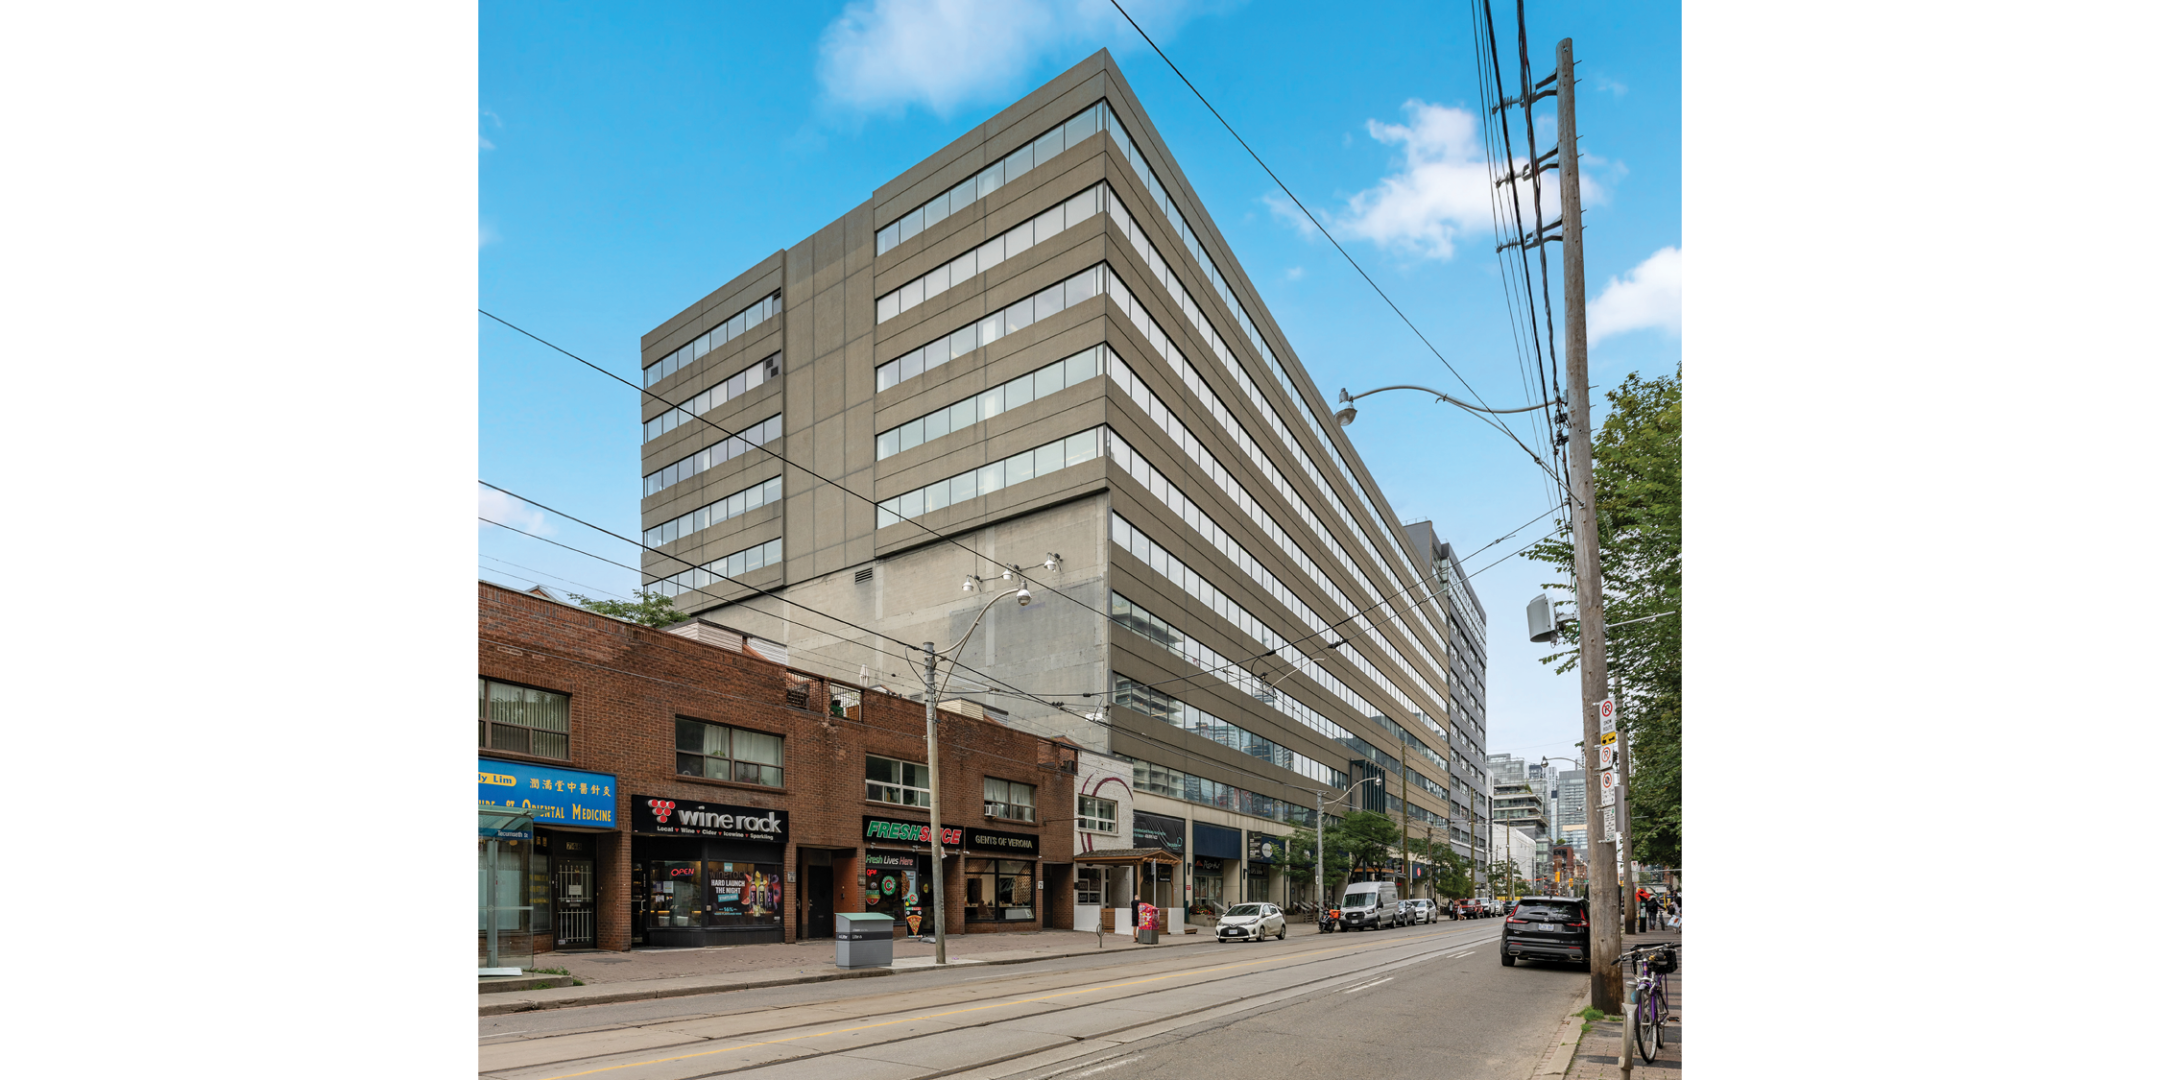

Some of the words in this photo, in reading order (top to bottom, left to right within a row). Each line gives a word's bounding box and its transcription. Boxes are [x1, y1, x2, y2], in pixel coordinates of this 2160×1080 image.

[493, 775, 512, 784] Lim
[572, 803, 611, 822] MEDICINE
[678, 805, 734, 829] wine
[735, 811, 782, 833] rack
[657, 825, 674, 833] Local
[750, 832, 774, 841] Sparkling
[867, 820, 962, 845] FRESHSCE
[975, 834, 997, 846] GENTS
[998, 837, 1008, 846] OF
[1008, 838, 1033, 849] VERONA
[866, 854, 883, 864] Fresh
[883, 855, 899, 865] Lives
[899, 856, 914, 866] Here
[671, 868, 695, 877] OPEN
